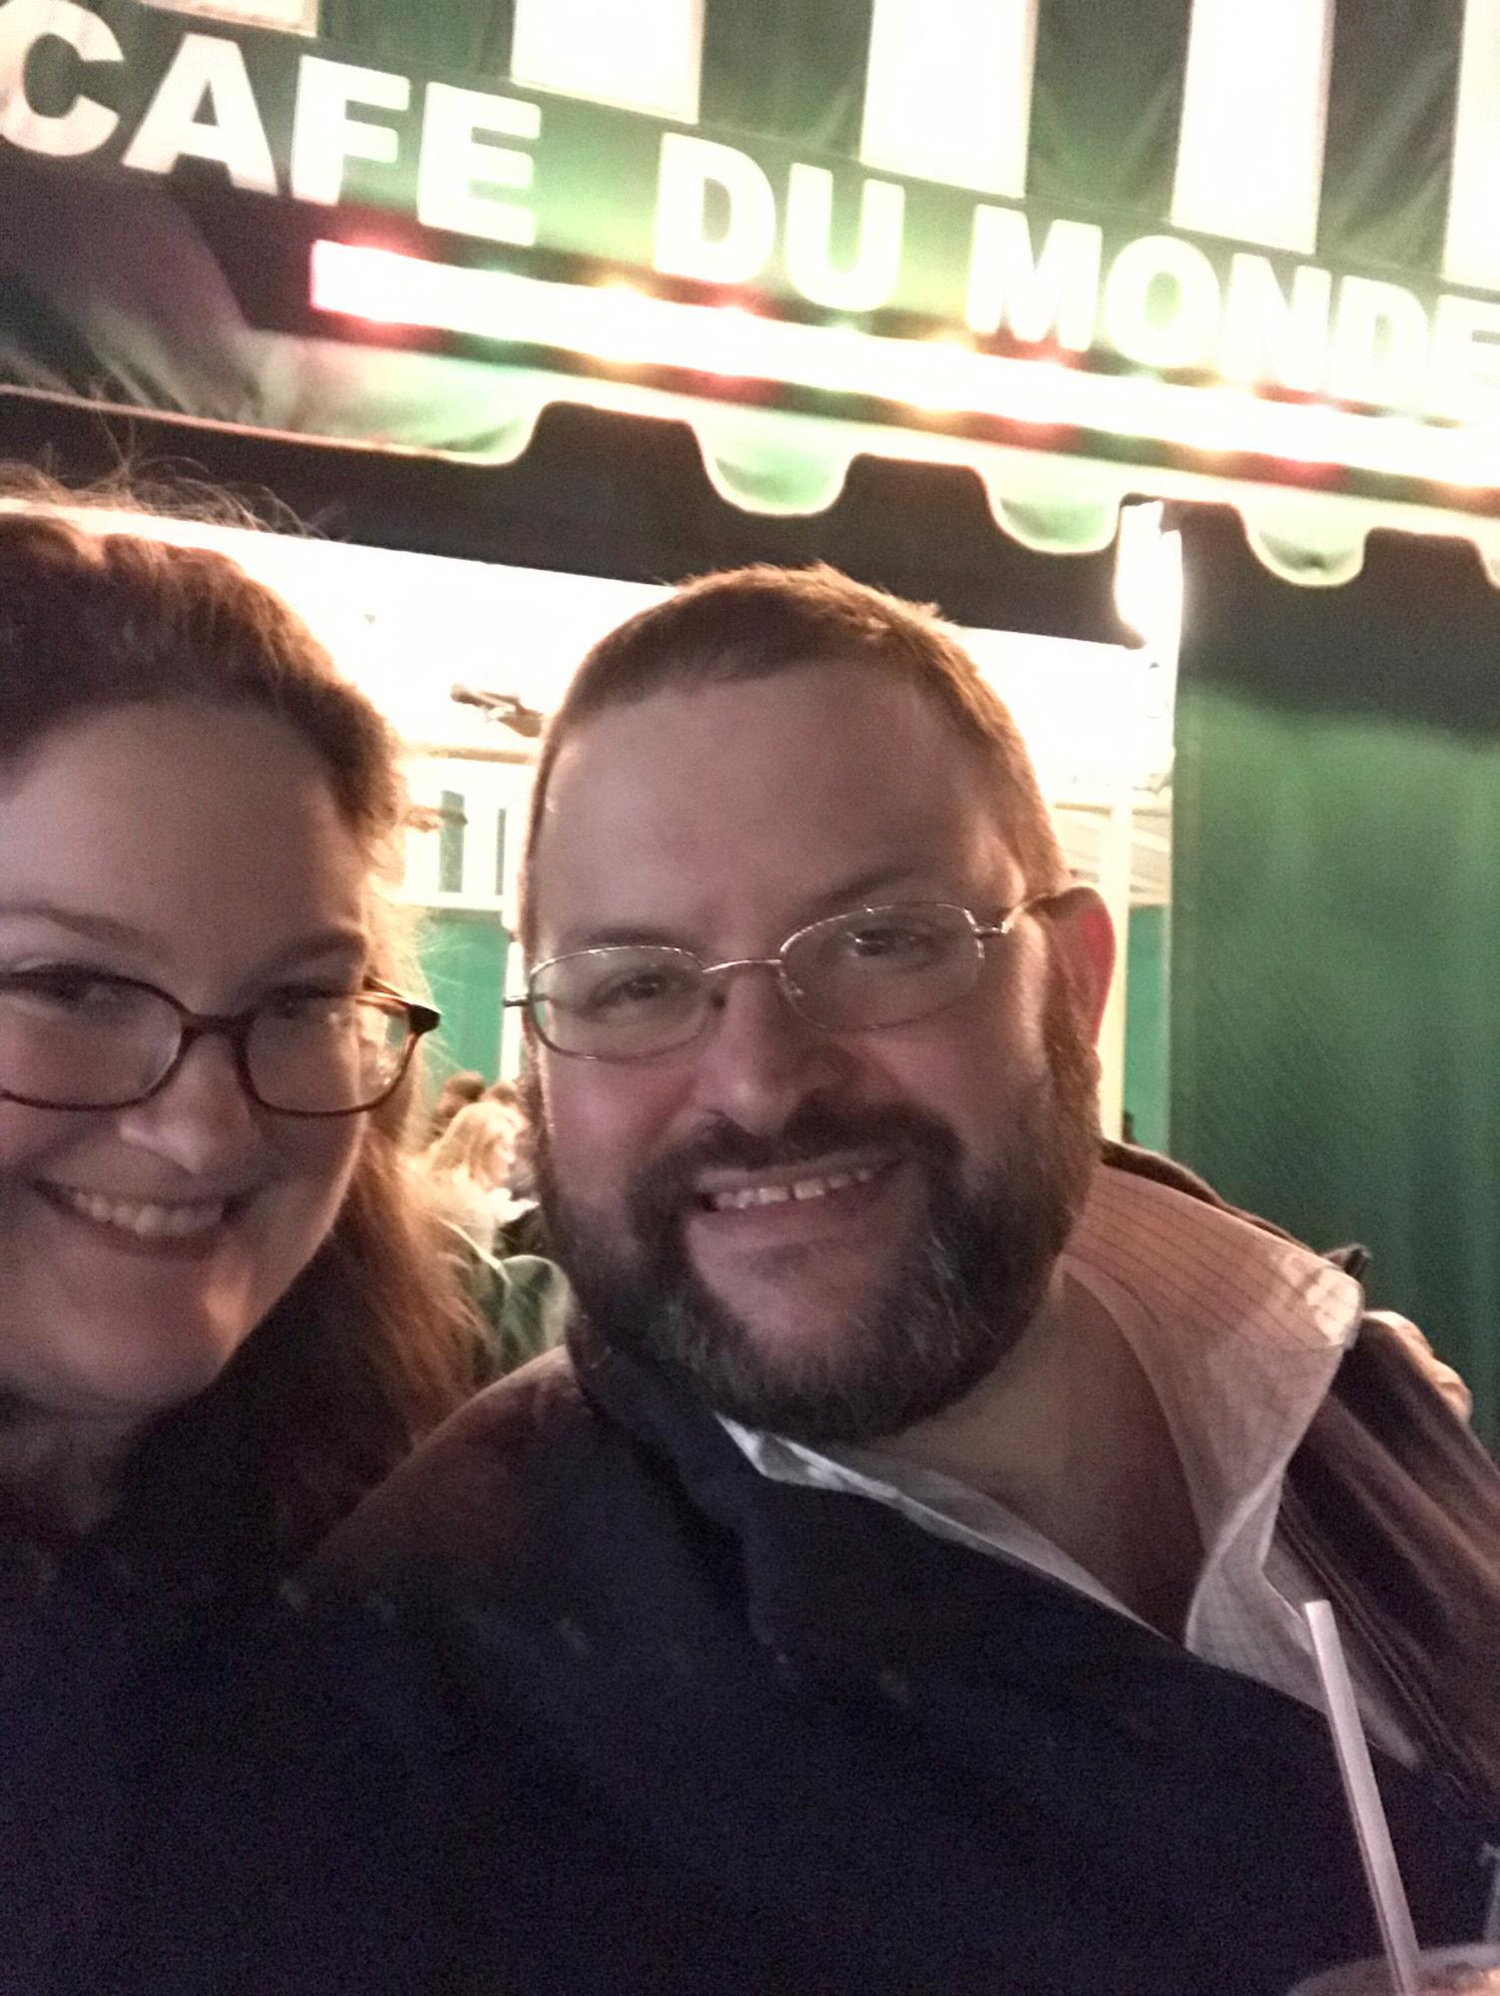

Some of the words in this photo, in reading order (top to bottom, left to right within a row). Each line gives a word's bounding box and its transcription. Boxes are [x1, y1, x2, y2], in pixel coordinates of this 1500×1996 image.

[0, 0, 542, 246] CAFE
[653, 131, 906, 312] DU
[965, 203, 1500, 425] MONDE
